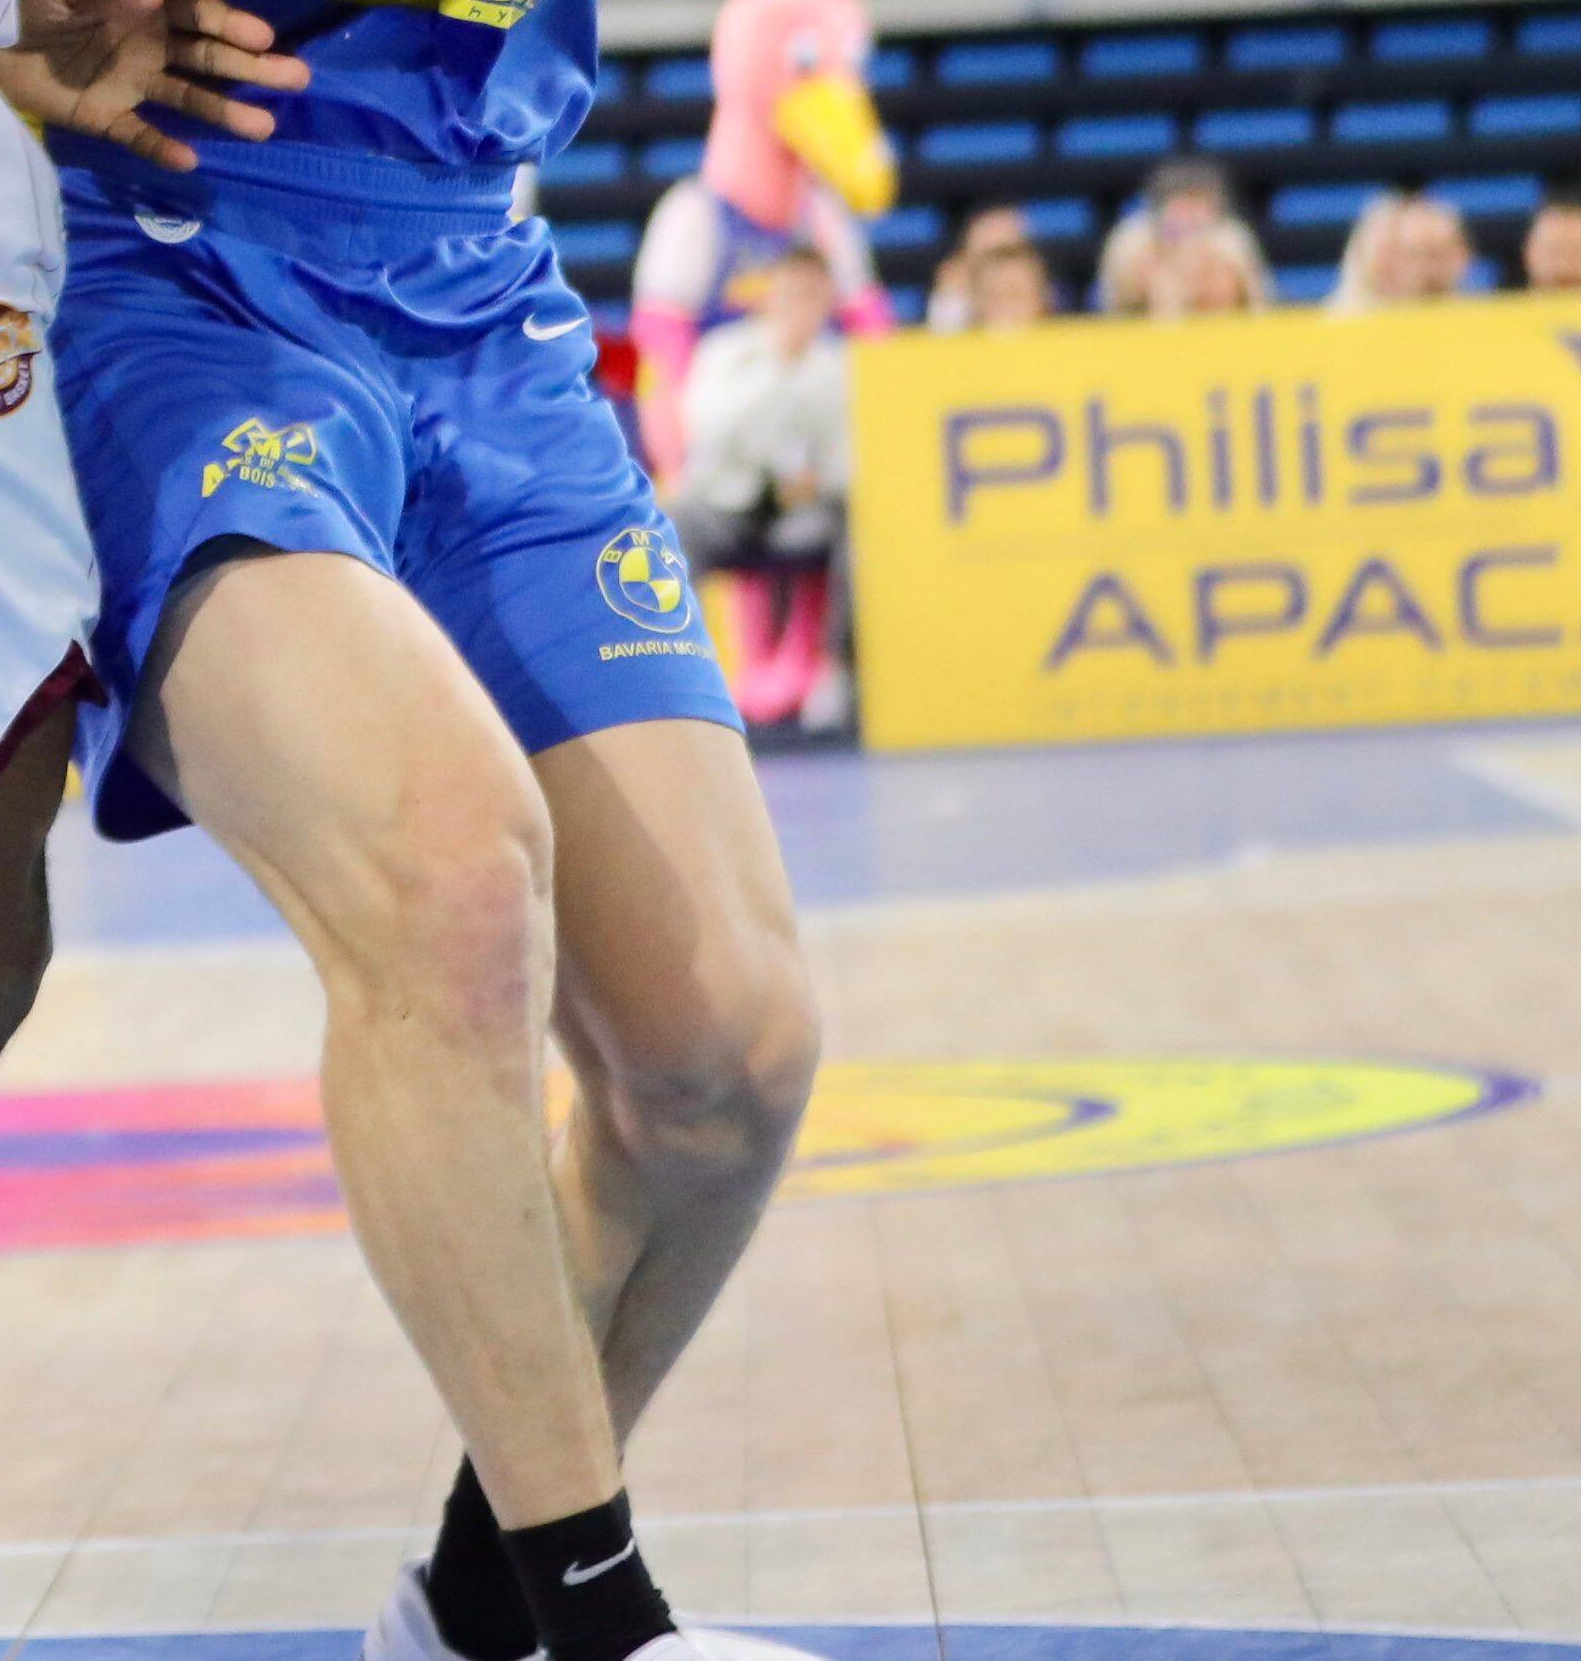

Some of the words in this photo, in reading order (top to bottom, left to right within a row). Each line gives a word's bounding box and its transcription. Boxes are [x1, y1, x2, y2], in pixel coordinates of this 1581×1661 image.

[941, 381, 1561, 529] Philisa
[598, 640, 672, 661] BAVARIA
[1040, 541, 1581, 676] APAC
